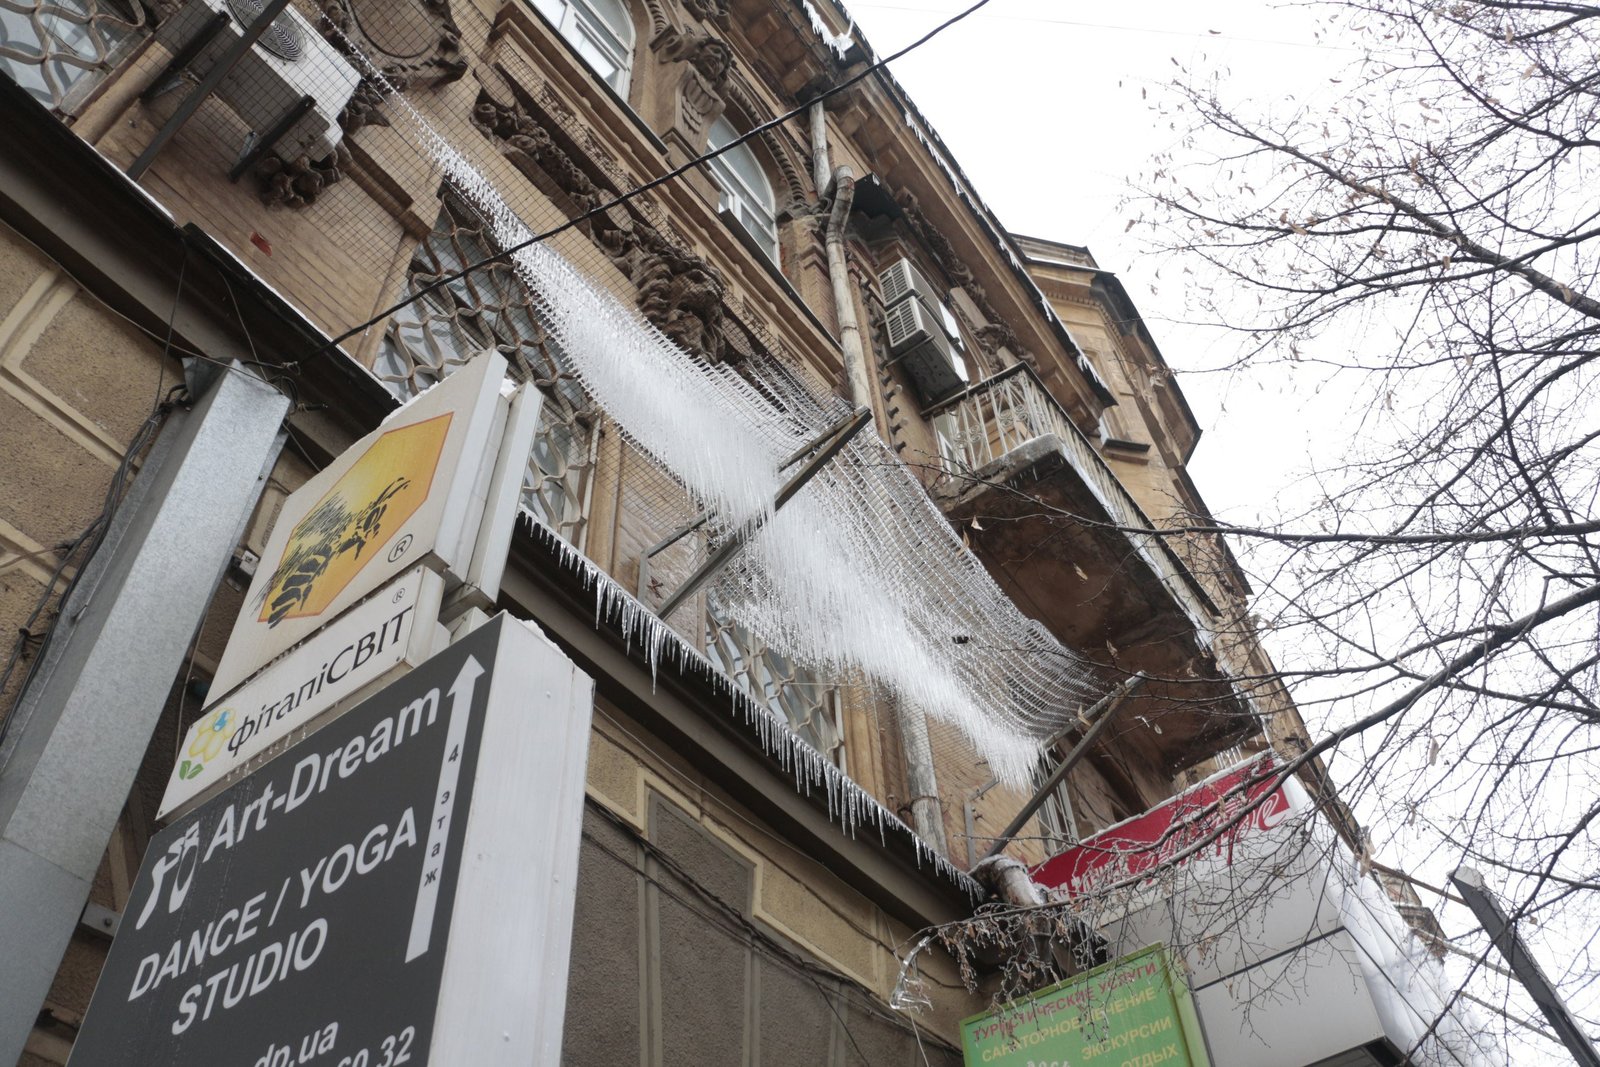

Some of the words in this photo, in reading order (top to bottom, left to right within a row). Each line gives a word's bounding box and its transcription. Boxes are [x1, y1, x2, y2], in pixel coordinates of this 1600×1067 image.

[202, 687, 441, 864] Art-Dream
[127, 891, 267, 1002] DANCE
[299, 806, 417, 908] YOGA
[171, 917, 328, 1035] STUDIO
[1081, 1016, 1172, 1061] ЭКСКУРСИИ
